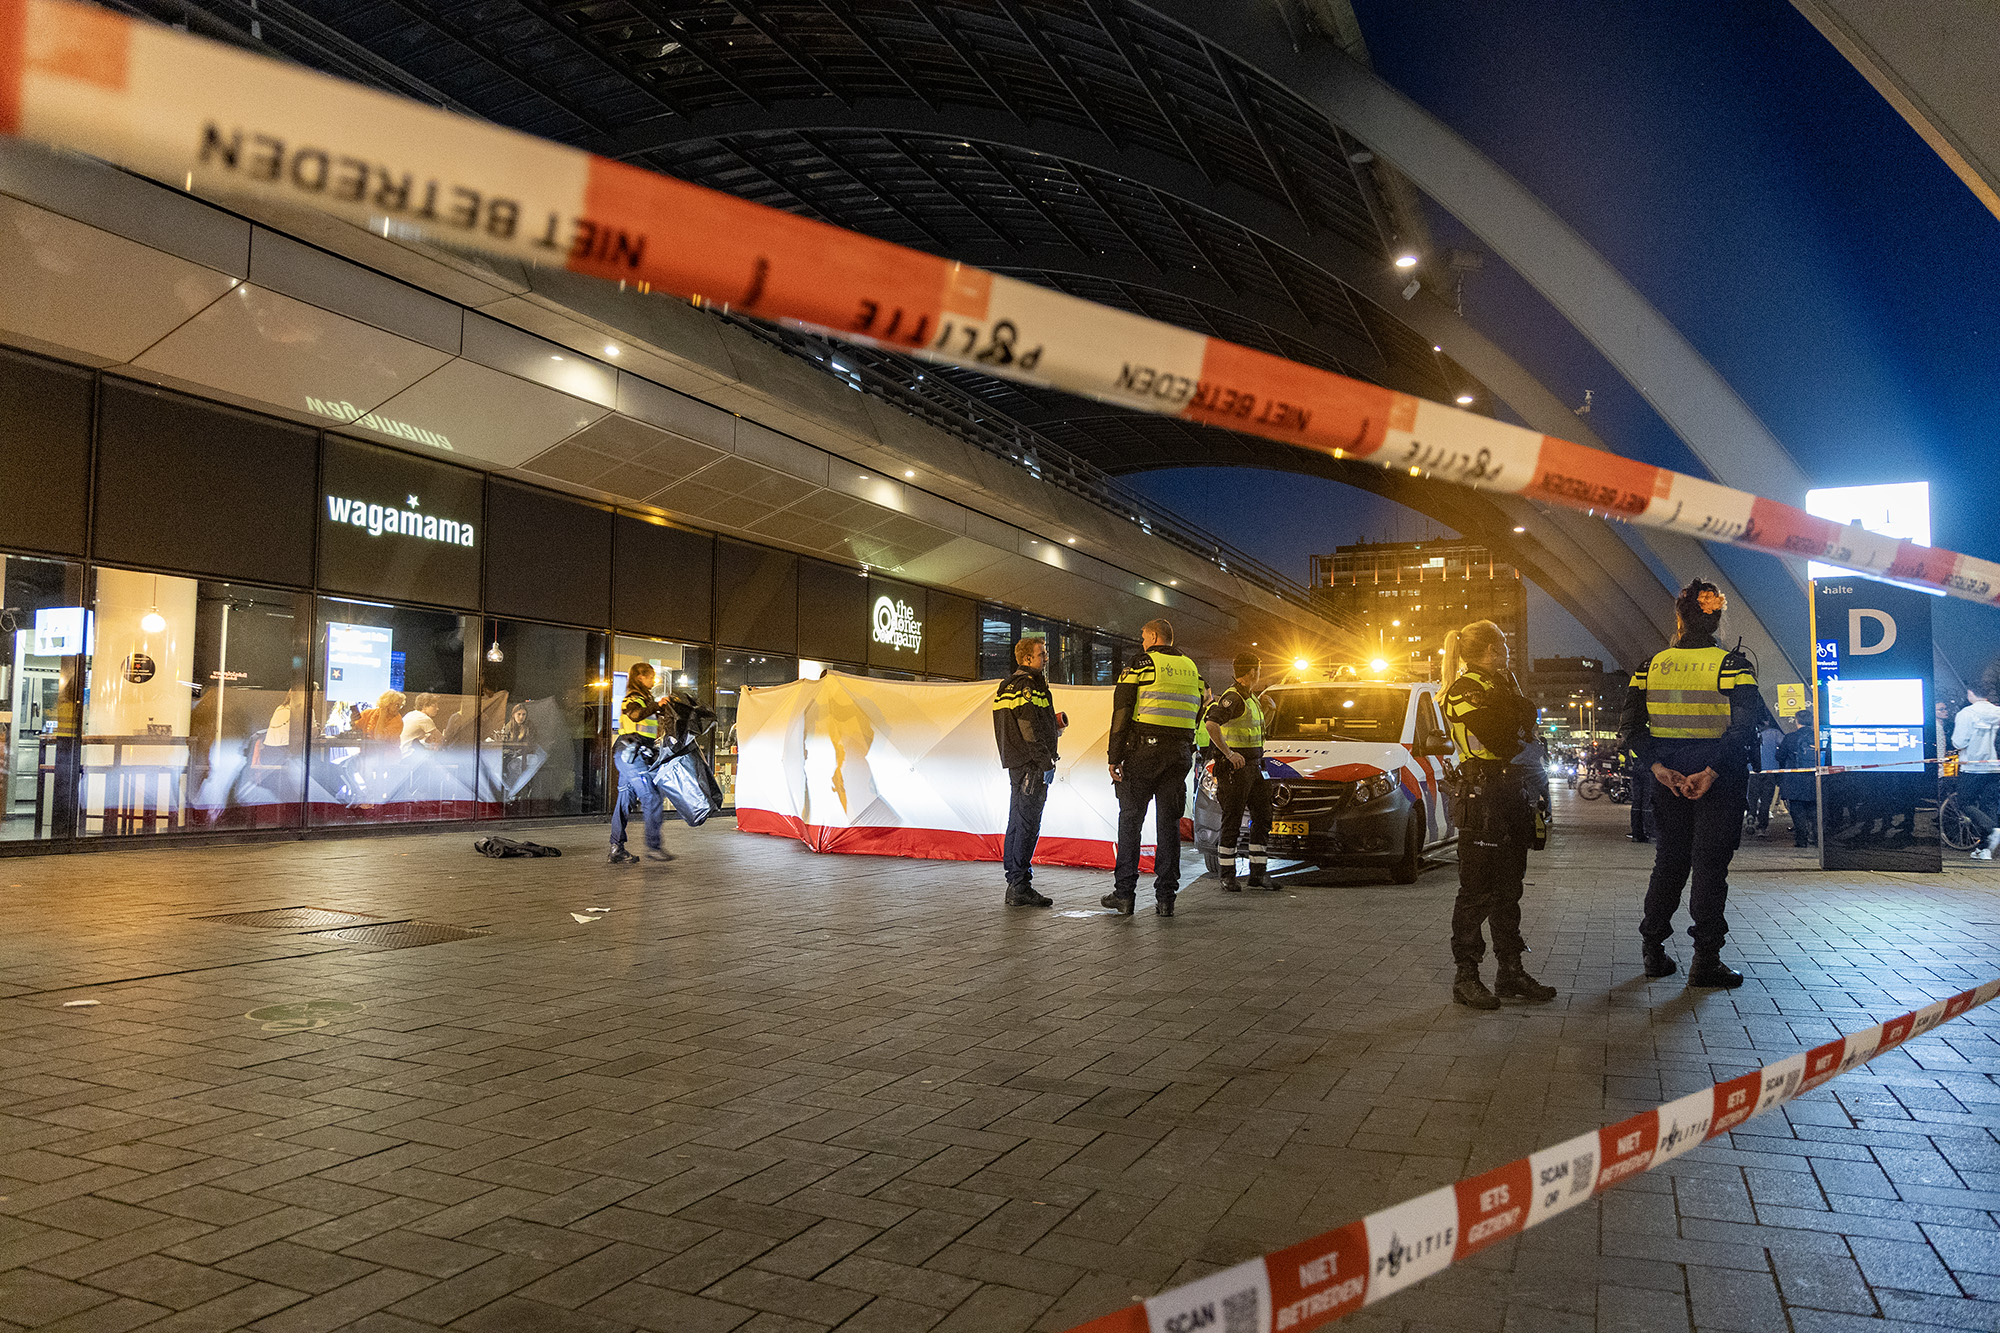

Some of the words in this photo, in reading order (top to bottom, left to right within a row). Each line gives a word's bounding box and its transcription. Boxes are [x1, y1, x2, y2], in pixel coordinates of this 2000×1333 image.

[199, 118, 521, 240] BETREDEN
[530, 212, 647, 269] NIET
[327, 495, 474, 547] wagamama
[1824, 586, 1853, 594] halte
[896, 600, 914, 620] the
[873, 628, 922, 654] company
[1848, 608, 1897, 656] D
[1160, 663, 1196, 677] POLITIE
[1651, 657, 1717, 675] POLITIE
[1766, 1074, 1785, 1092] SCAN
[1660, 1118, 1709, 1152] POLITIE
[1540, 1160, 1569, 1187] SCAN
[1479, 1183, 1510, 1213] IETS
[1376, 1228, 1454, 1277] POLITIE
[1299, 1251, 1339, 1289] NIET
[1163, 1302, 1217, 1333] SCAN
[1276, 1275, 1365, 1331] BETREDEN
